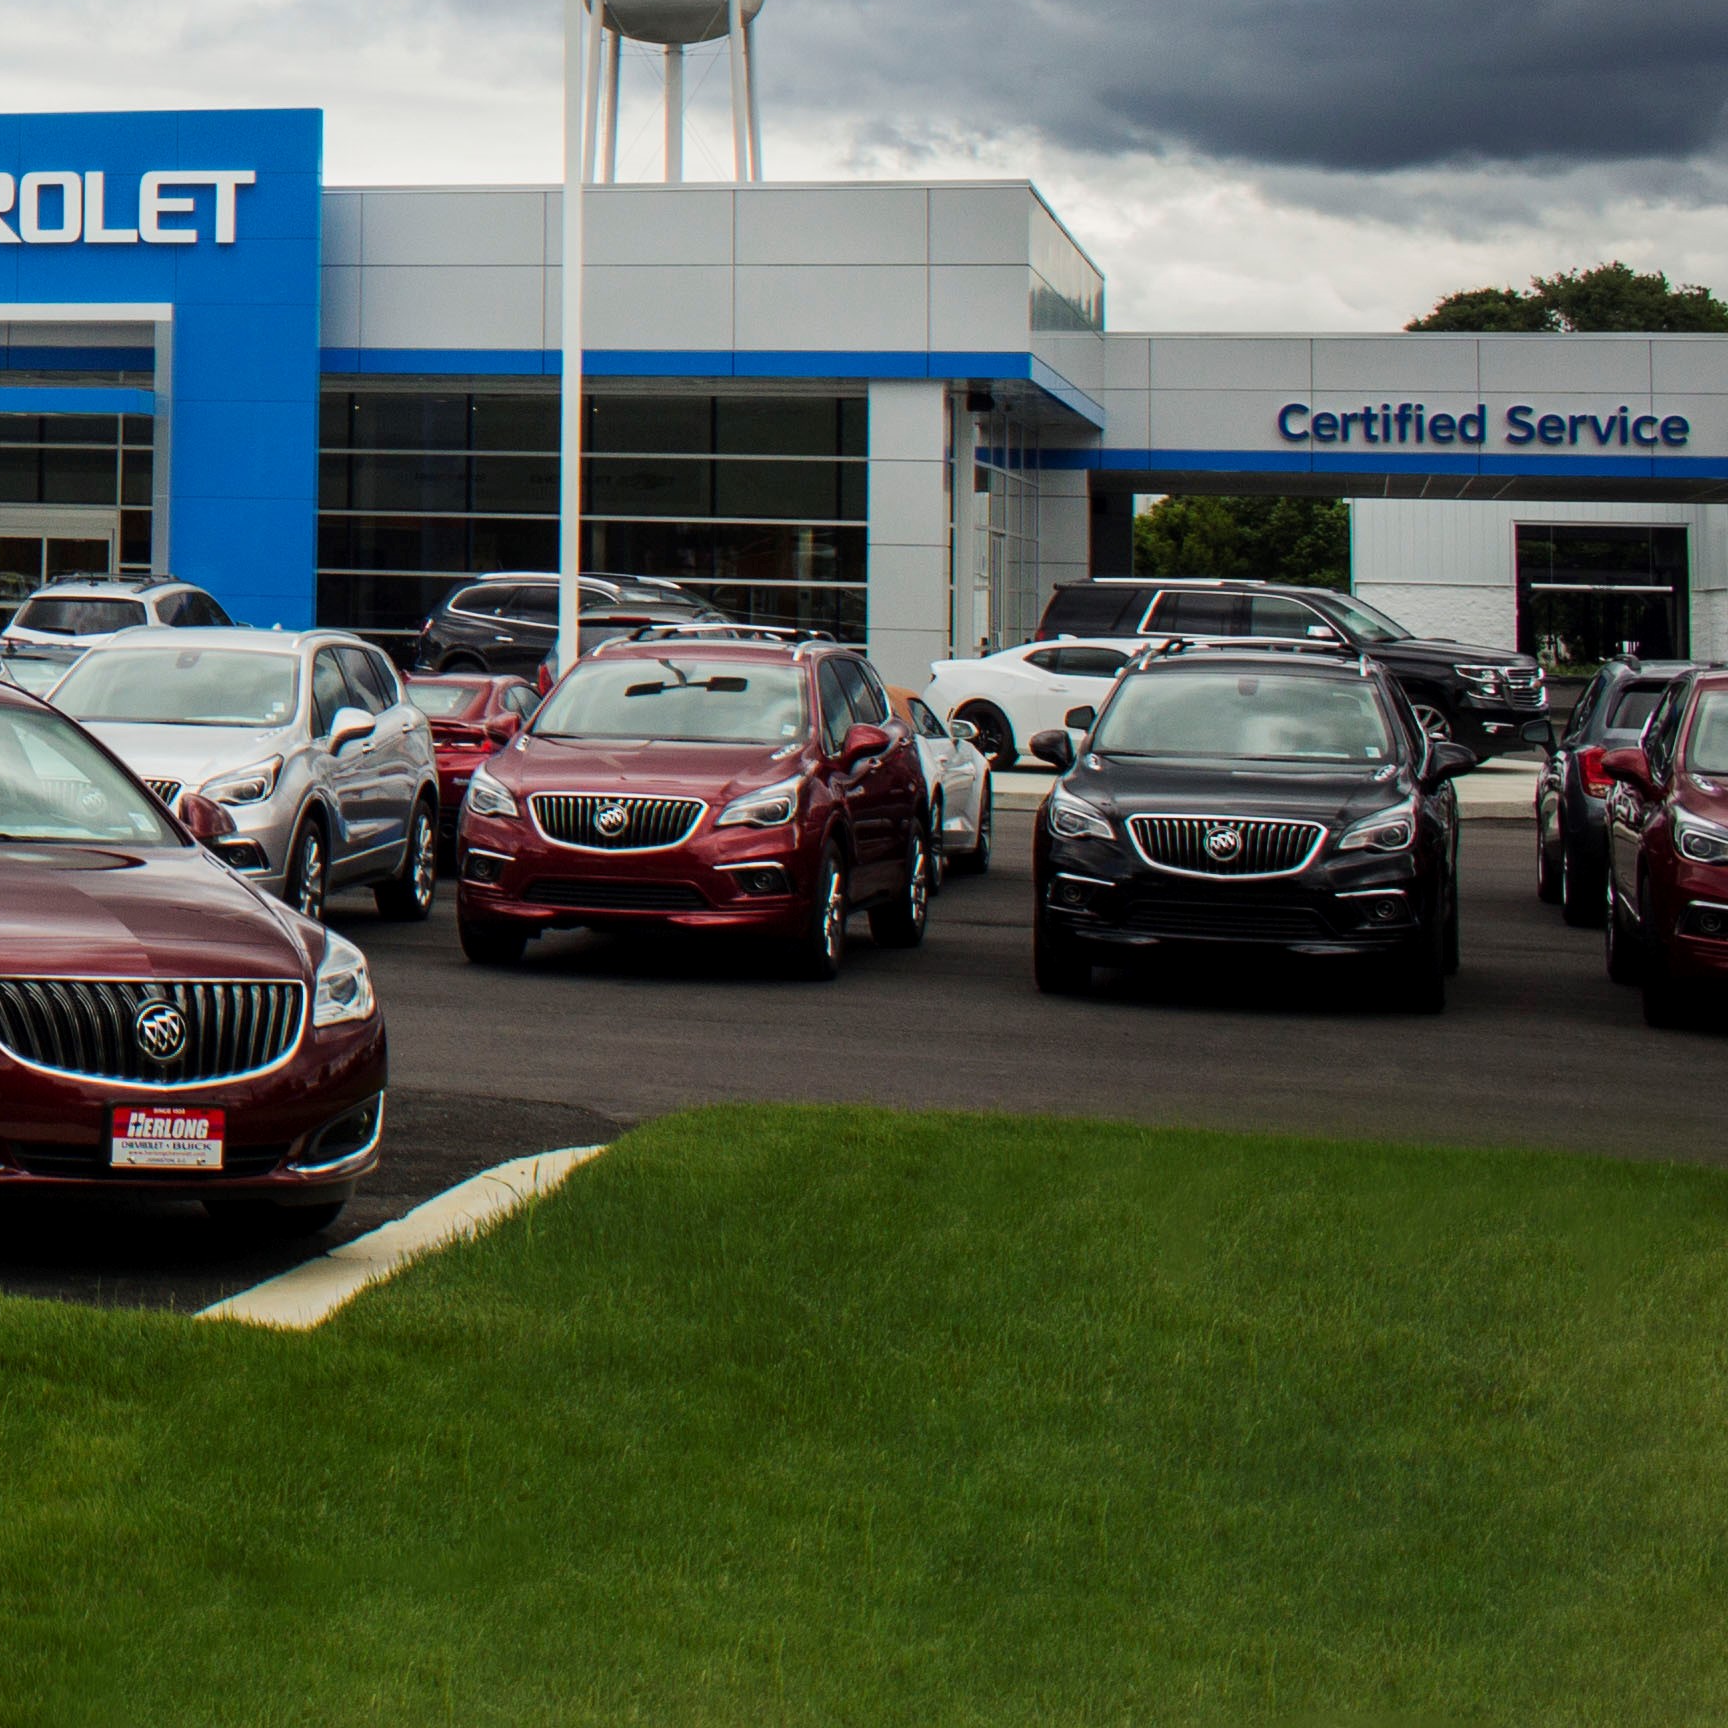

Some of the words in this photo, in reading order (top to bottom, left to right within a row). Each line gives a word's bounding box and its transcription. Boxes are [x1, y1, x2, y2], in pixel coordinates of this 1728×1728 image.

[1277, 402, 1487, 444] Certified
[1505, 404, 1691, 447] Service
[127, 1111, 210, 1140] HERLONG
[172, 1141, 212, 1151] BUICK
